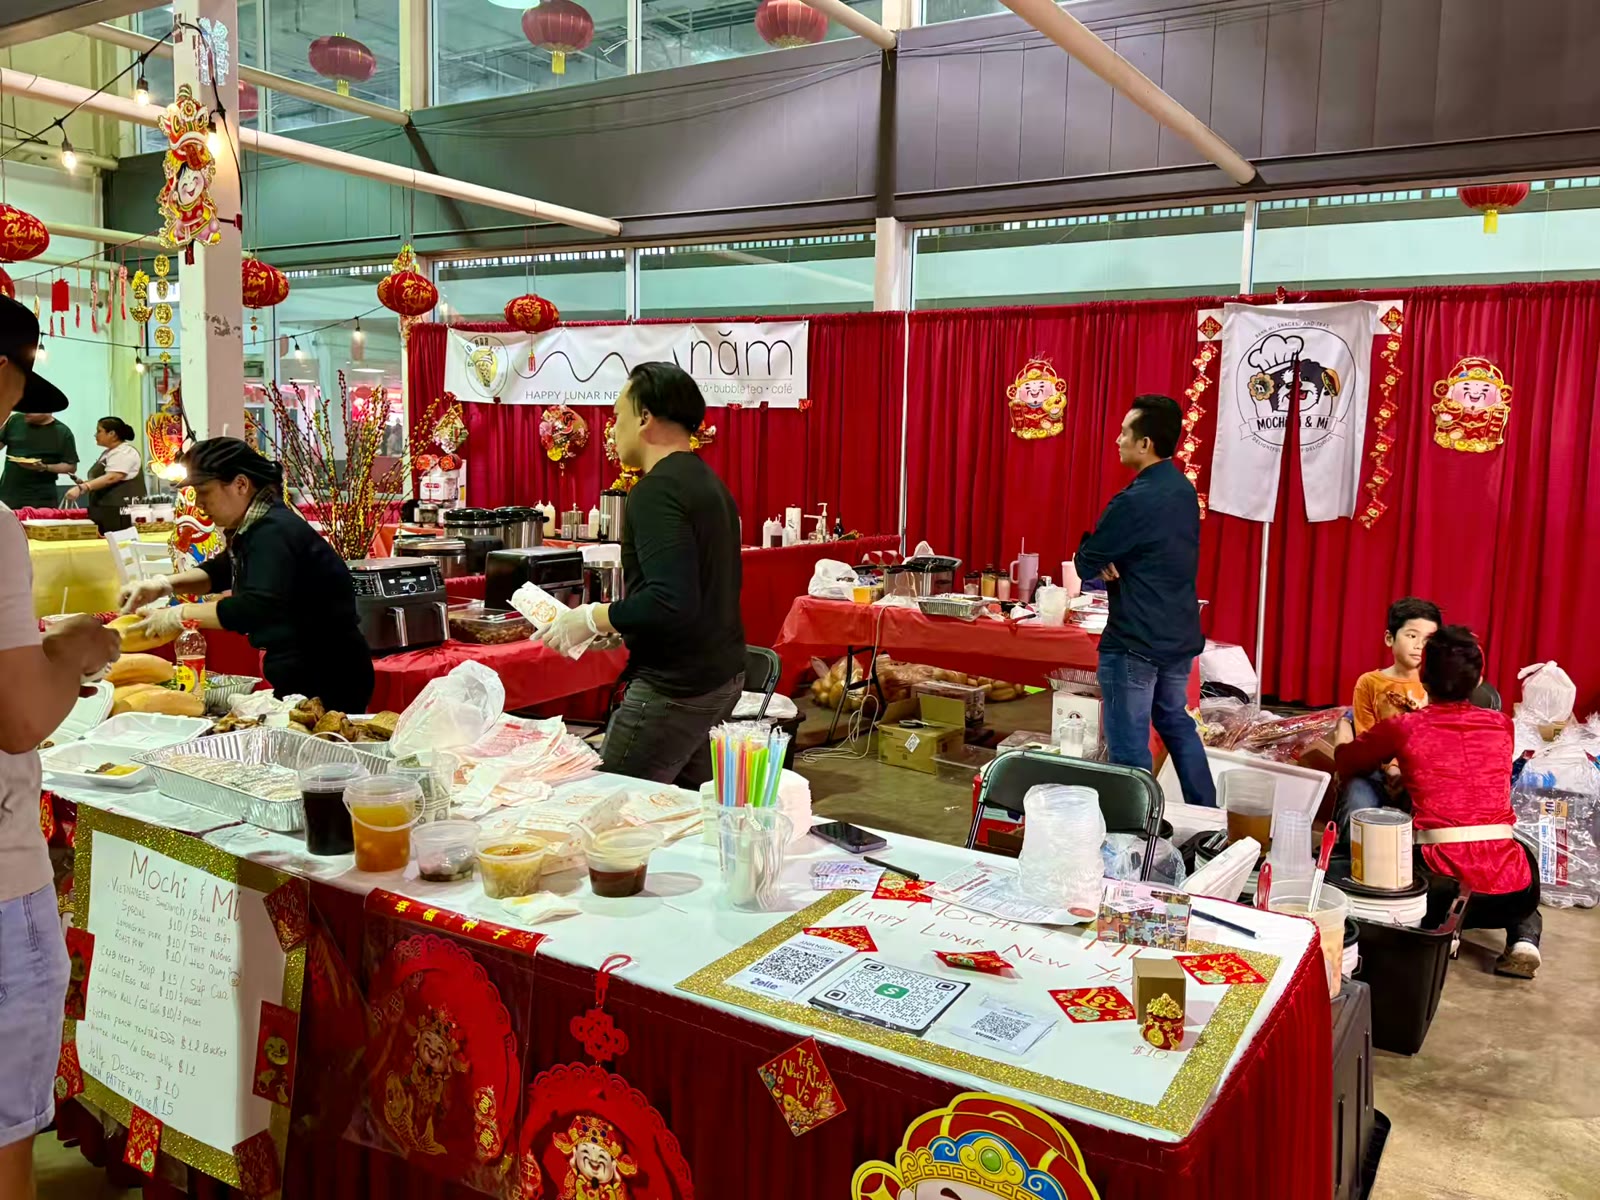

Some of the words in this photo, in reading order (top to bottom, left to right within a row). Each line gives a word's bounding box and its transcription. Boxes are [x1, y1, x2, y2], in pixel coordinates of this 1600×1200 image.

[690, 330, 793, 376] năm
[526, 391, 561, 400] HAPPY
[565, 391, 601, 400] LUNAR
[604, 391, 620, 400] NE
[771, 384, 793, 395] café
[130, 849, 188, 899] Mochi
[212, 884, 241, 922] Mi
[842, 900, 908, 927] HAPPY
[920, 922, 986, 948] LUNAR
[1002, 944, 1071, 969] NEW
[117, 953, 135, 967] MEAT
[137, 960, 156, 978] SOUP
[750, 977, 779, 991] Zelle
